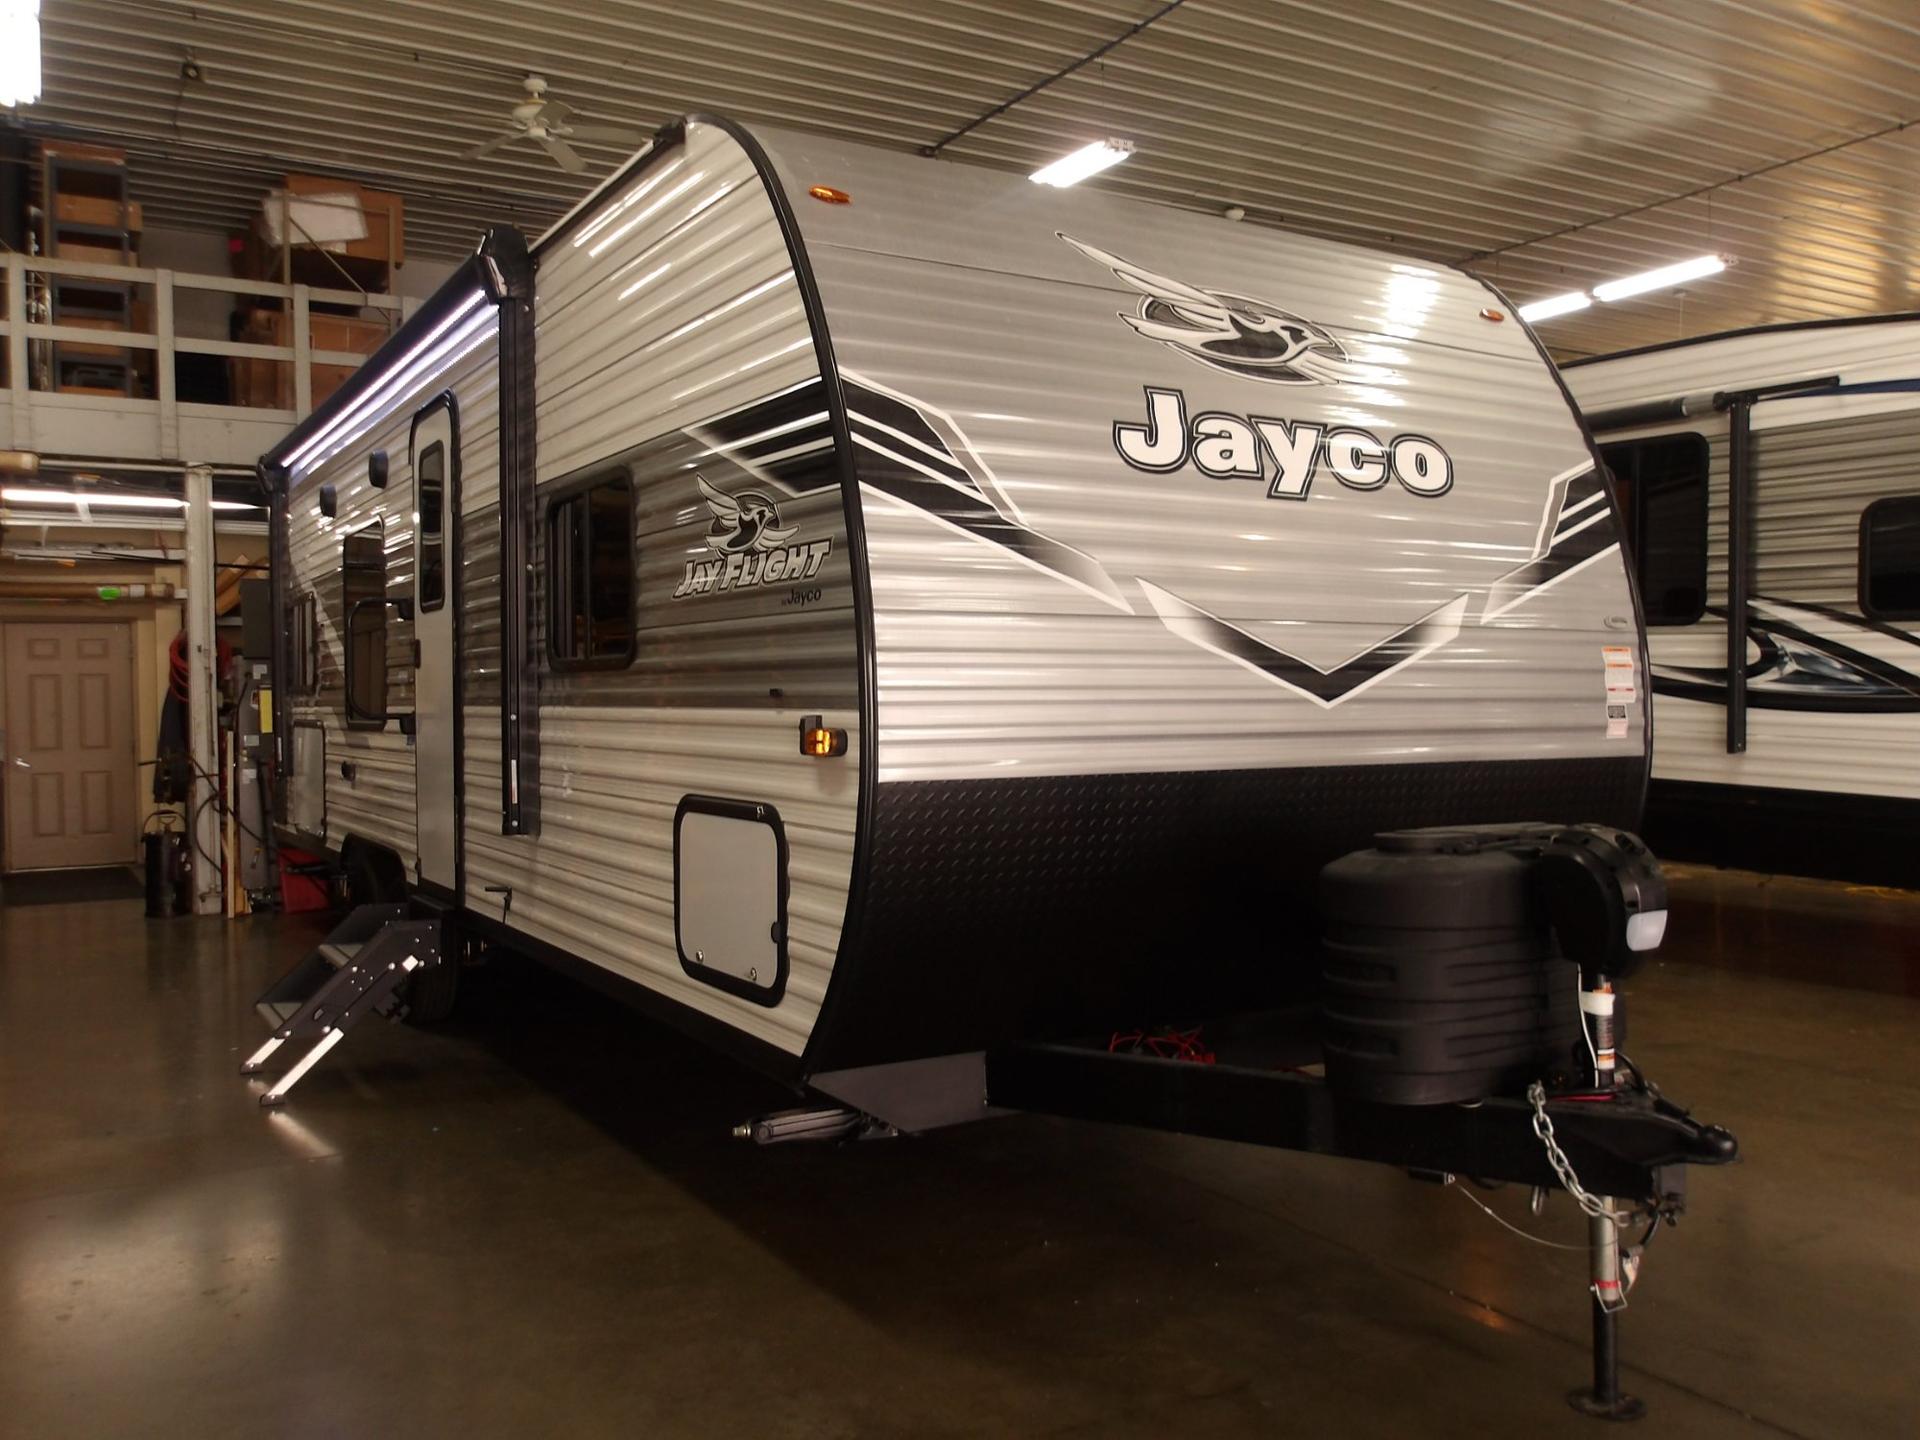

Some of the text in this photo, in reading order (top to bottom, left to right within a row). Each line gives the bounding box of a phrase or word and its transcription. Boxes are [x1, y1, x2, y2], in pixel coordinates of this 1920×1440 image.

[1113, 386, 1453, 501] Jayco
[673, 538, 833, 599] JAY FLIGHT
[787, 589, 822, 606] Jayco
